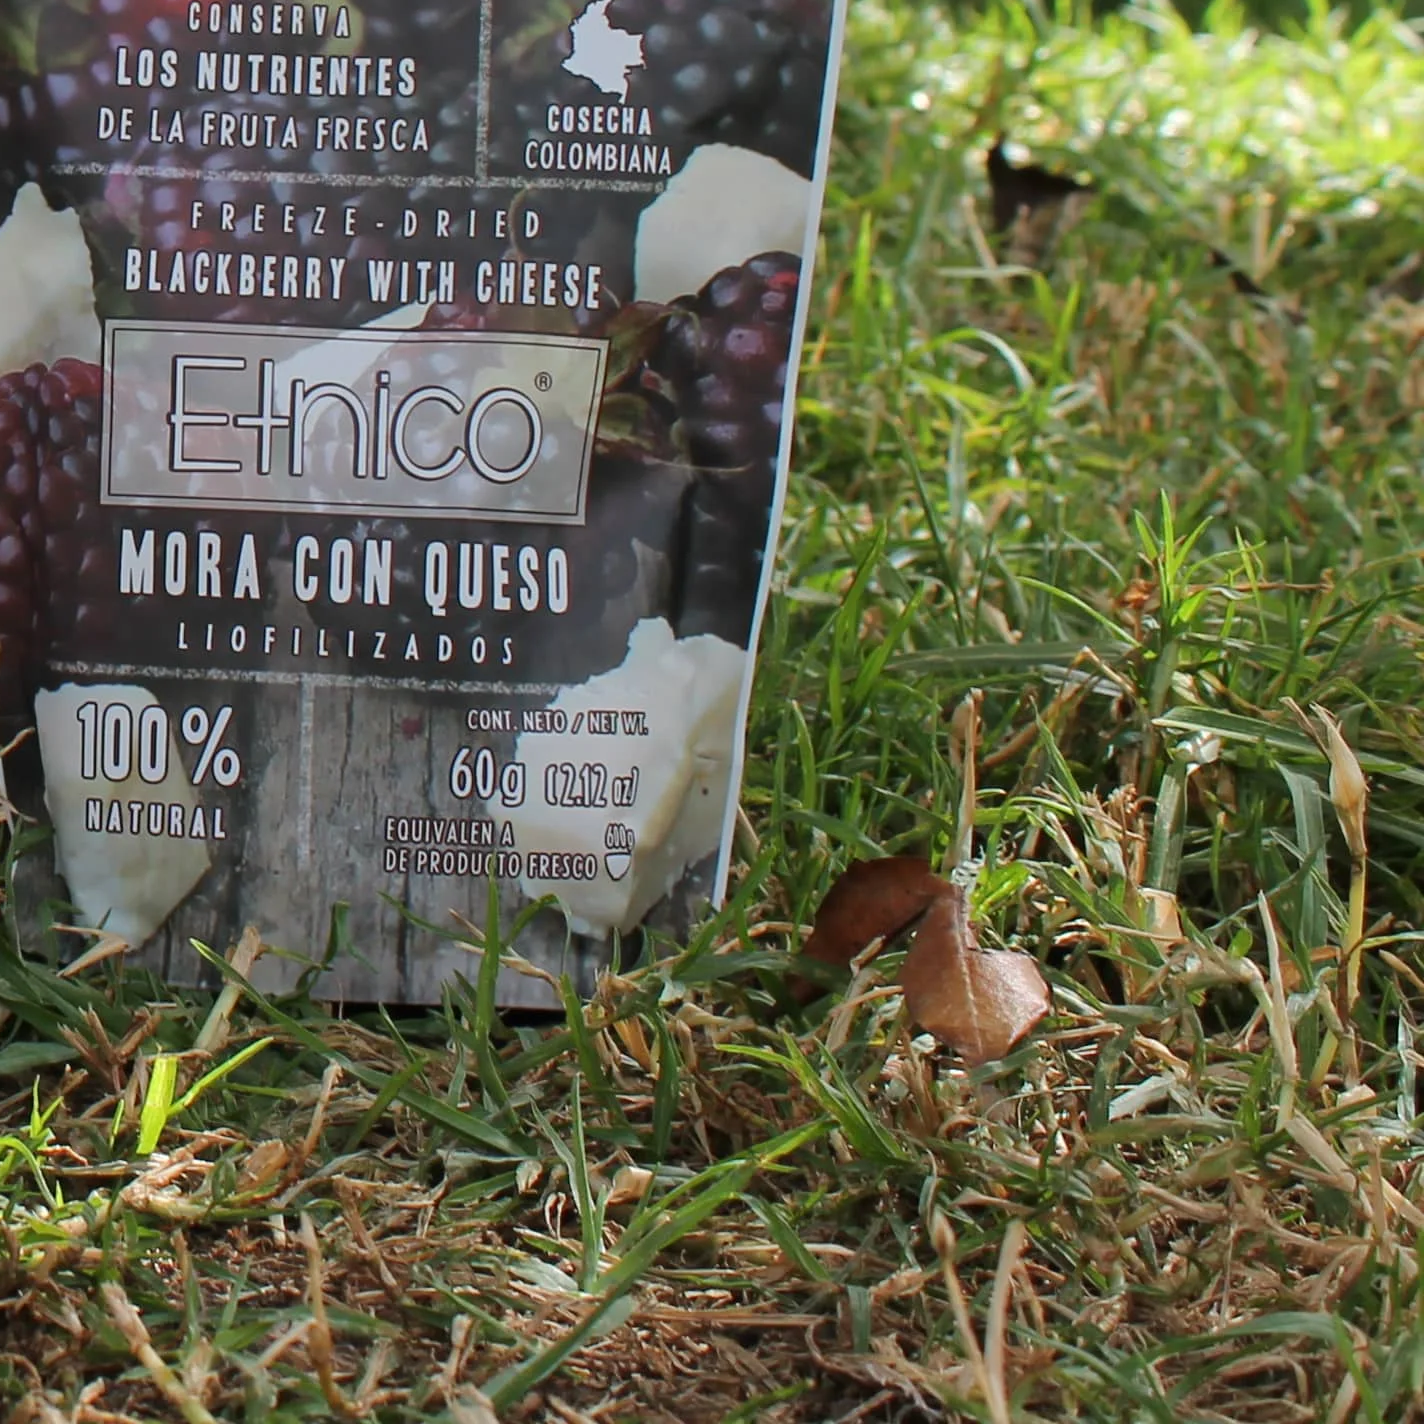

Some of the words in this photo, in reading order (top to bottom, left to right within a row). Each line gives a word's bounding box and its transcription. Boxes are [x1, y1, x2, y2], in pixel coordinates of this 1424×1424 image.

[188, 0, 352, 39] CONSERVA
[116, 47, 178, 88] LOS
[196, 49, 417, 98] NUTRIENTES
[97, 106, 133, 142] DE
[149, 107, 185, 144] LA
[201, 109, 300, 150] FRUTA
[315, 117, 430, 153] FRESCA
[546, 104, 653, 137] COSECHA
[524, 140, 673, 176] COLOMBIANA
[124, 247, 345, 302] BLACKBERRY
[368, 259, 456, 306] WITH
[476, 259, 602, 311] CHEESE
[118, 527, 262, 601] MORA
[293, 533, 394, 607] CON
[424, 540, 570, 618] QUESO
[177, 620, 515, 667] LIOFILIZADOS
[467, 708, 518, 732] CONT.
[522, 710, 567, 733] NETO
[571, 712, 584, 734] /
[587, 710, 618, 734] NET
[621, 710, 649, 735] WT.
[450, 745, 526, 807] 60g
[86, 798, 226, 839] NATURAL
[385, 817, 494, 846] EQUIVALEN
[501, 822, 515, 846] A
[605, 822, 635, 853] 600g
[384, 848, 408, 873] DE
[529, 852, 597, 880] FRESCO
